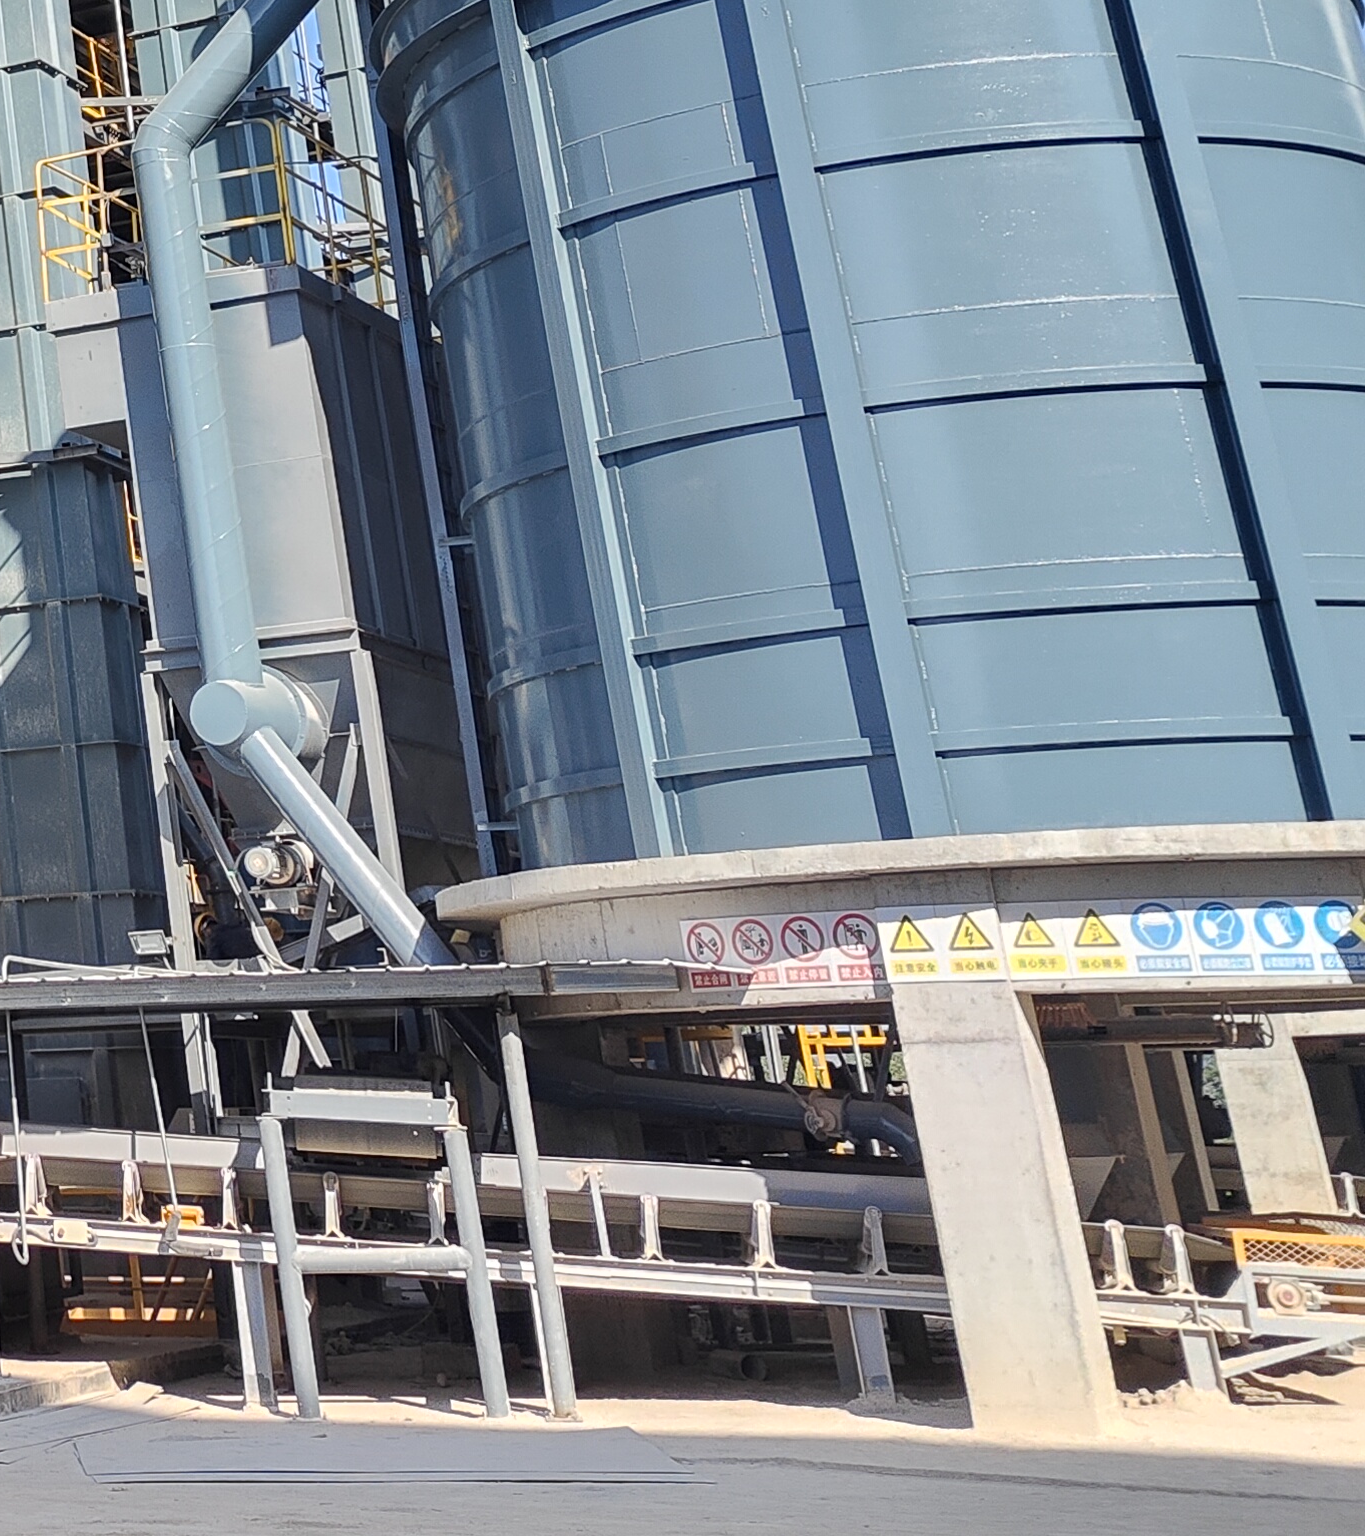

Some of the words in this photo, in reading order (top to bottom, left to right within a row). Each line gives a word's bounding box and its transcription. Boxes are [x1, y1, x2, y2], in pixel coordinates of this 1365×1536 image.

[839, 966, 884, 978] 禁止入内
[894, 961, 937, 973] 注意安全
[953, 960, 998, 972] 当心触电
